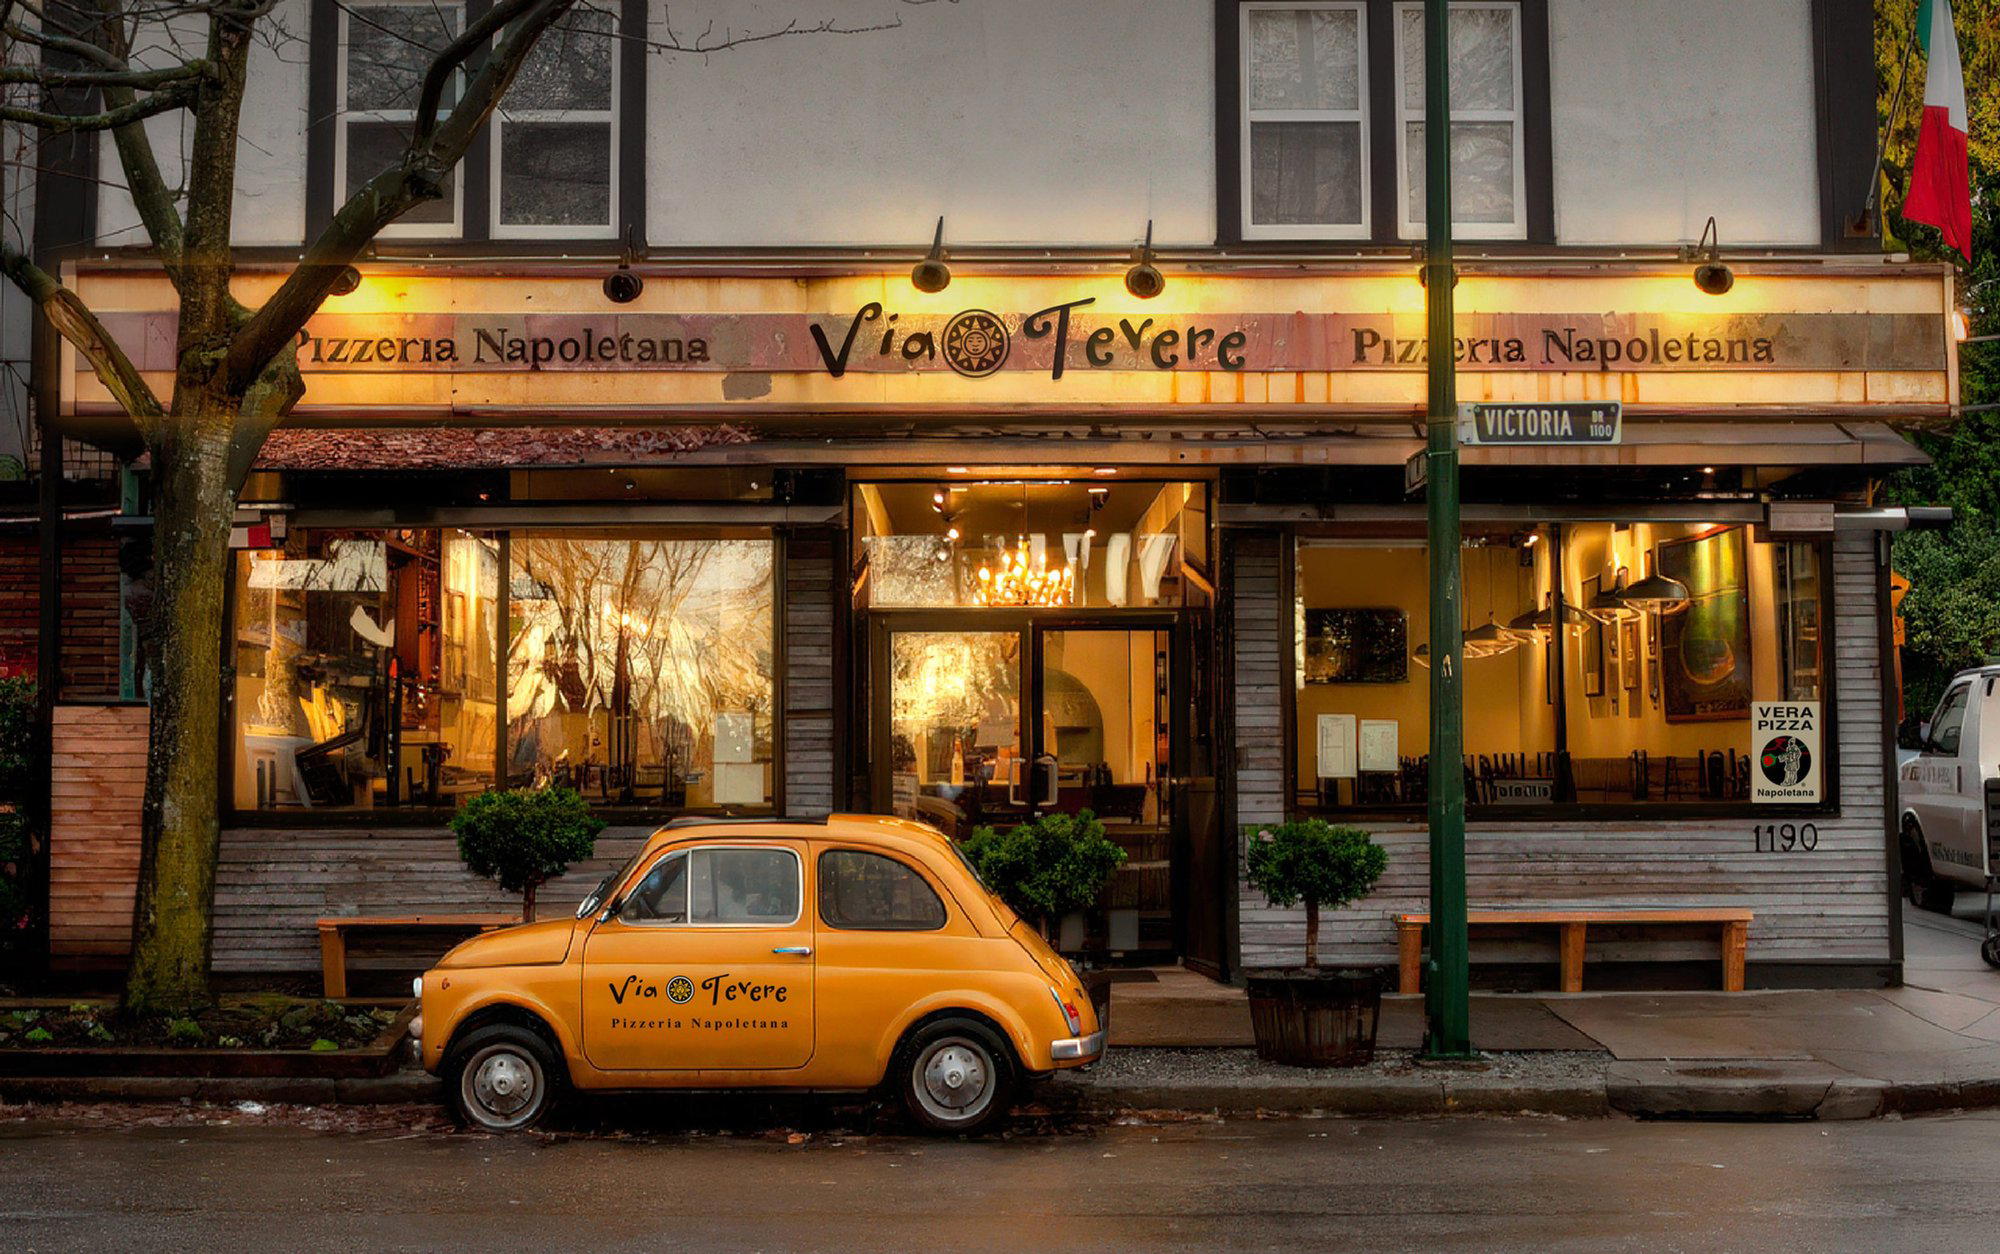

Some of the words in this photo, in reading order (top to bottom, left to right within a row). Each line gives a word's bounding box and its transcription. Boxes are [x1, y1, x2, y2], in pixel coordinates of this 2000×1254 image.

[810, 302, 936, 378] Via
[1023, 297, 1247, 380] Tevere
[472, 328, 711, 370] Napoletana
[1351, 328, 1526, 363] Pizeria
[1541, 328, 1775, 371] Napoletana
[1484, 409, 1573, 437] VICTORIA
[1591, 411, 1604, 423] DR
[1590, 425, 1613, 437] 1100
[1759, 706, 1814, 718] VERA
[1758, 720, 1813, 731] PIZZA
[1757, 788, 1815, 798] Napoletana
[1753, 823, 1818, 852] 1190
[609, 975, 658, 1005] Via
[701, 973, 787, 1006] Tevere
[611, 1018, 682, 1029] Pizzeria
[691, 1018, 789, 1031] Napoletana
